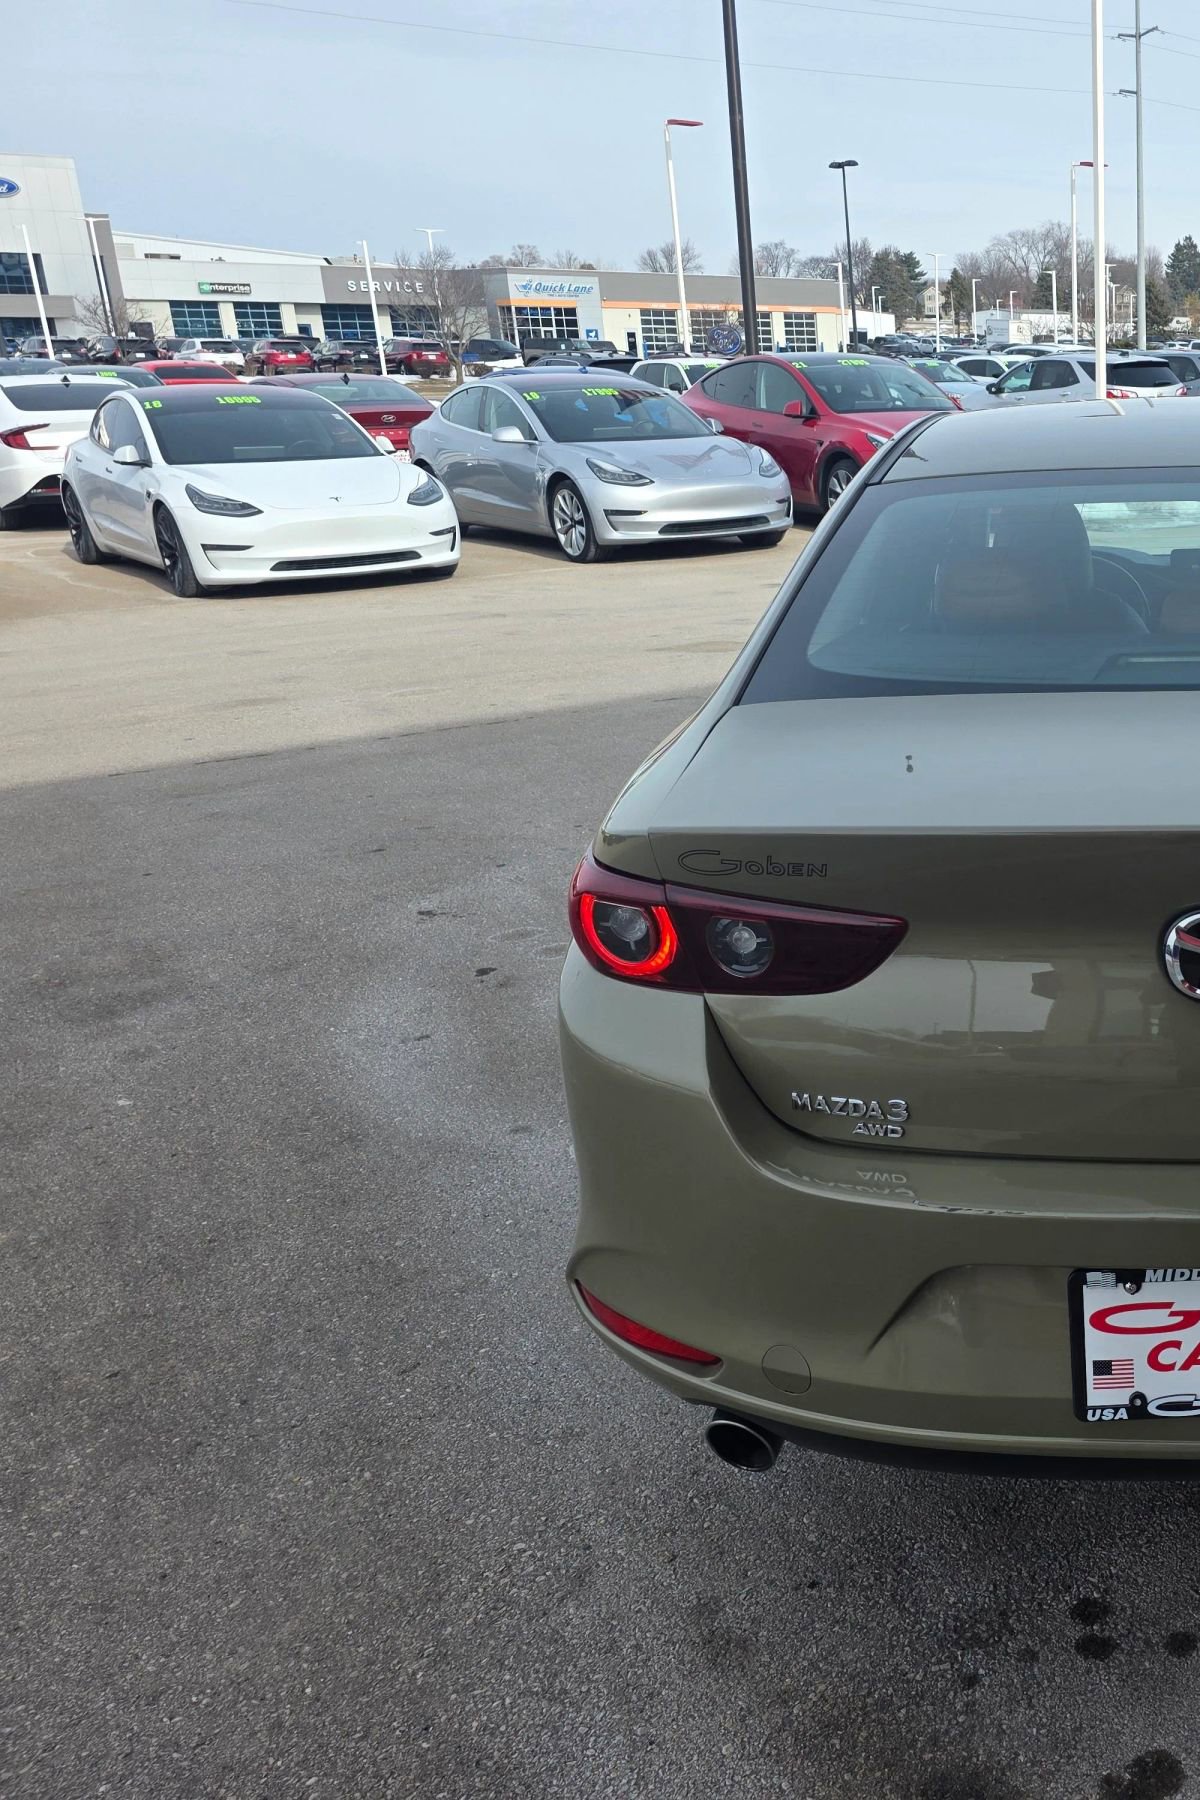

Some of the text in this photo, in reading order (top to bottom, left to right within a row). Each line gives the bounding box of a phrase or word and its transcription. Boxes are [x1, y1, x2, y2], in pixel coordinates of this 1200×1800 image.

[200, 284, 250, 293] enterprise
[347, 280, 424, 293] SERVICE
[534, 282, 594, 294] Quick Lane
[852, 1122, 905, 1138] AWD
[1086, 1407, 1129, 1422] USA
